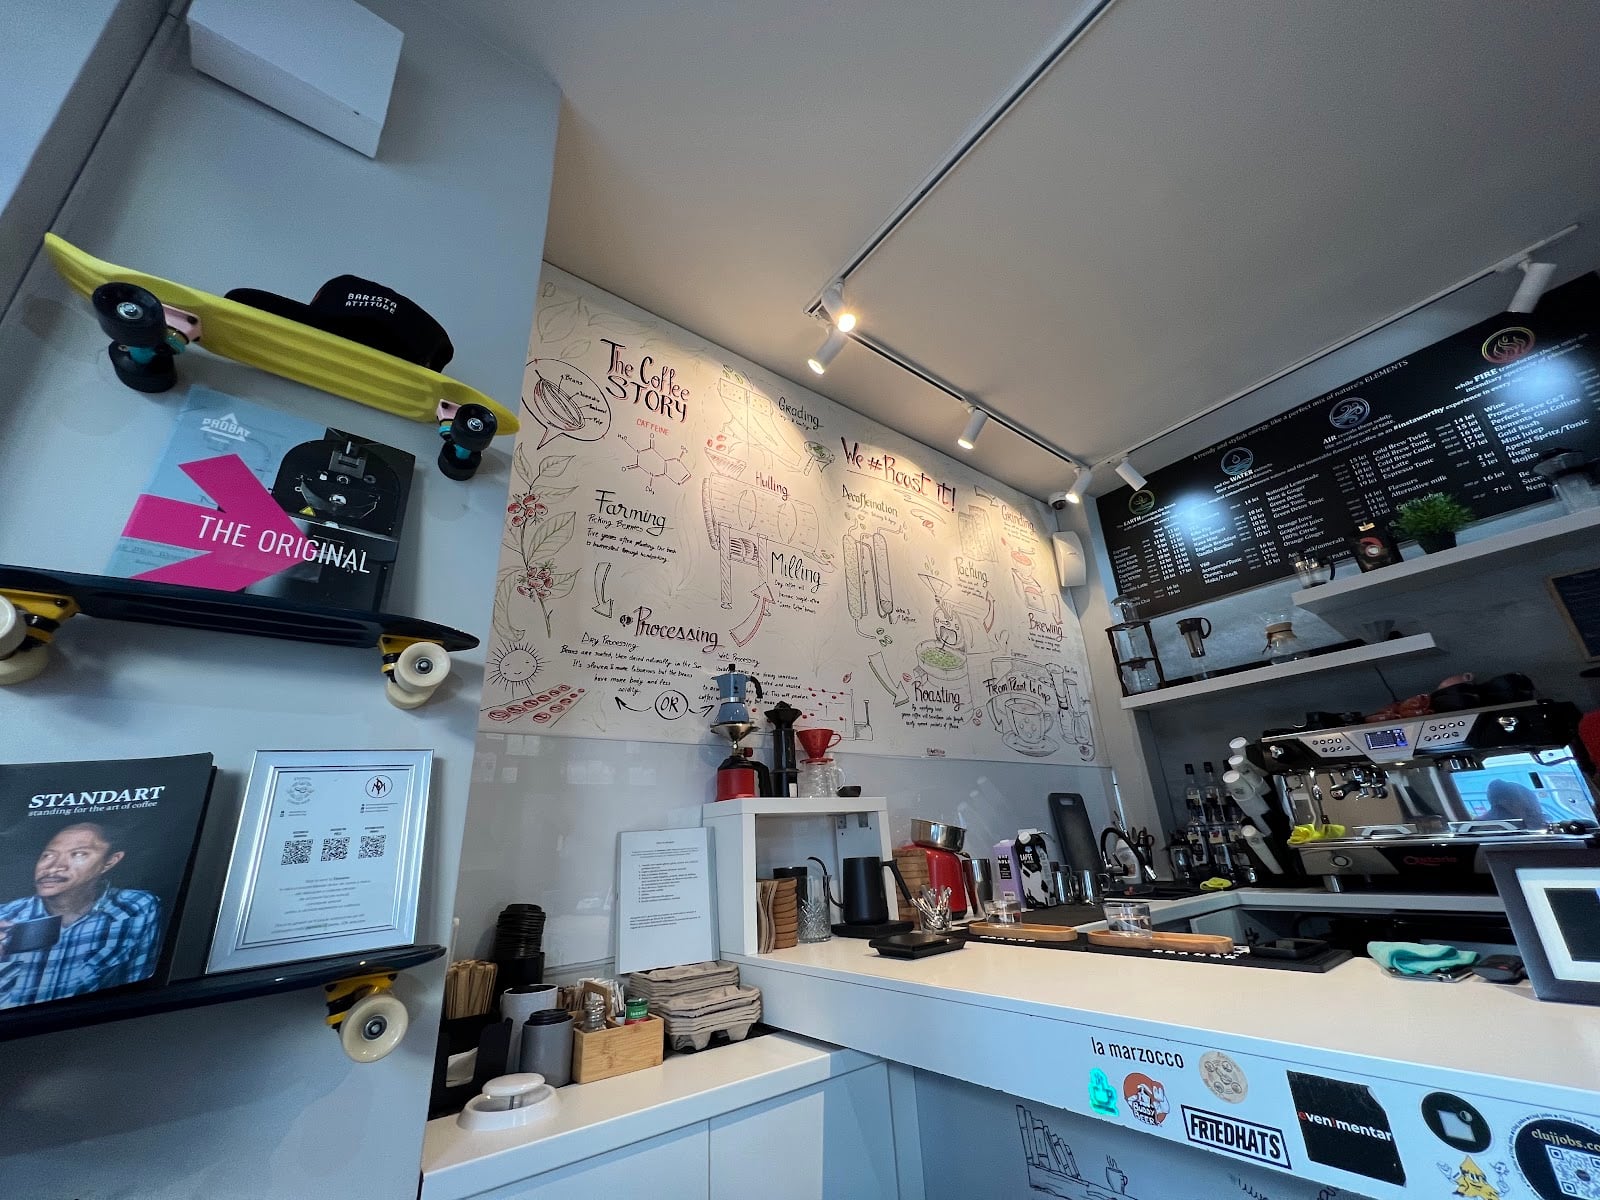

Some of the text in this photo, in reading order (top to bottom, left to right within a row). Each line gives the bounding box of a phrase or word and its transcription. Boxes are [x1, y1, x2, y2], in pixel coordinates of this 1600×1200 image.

[345, 301, 396, 315] ATTITUDE
[347, 293, 398, 309] BARISTA
[600, 338, 691, 402] The Coffee
[1454, 367, 1498, 392] while FIRE
[1465, 374, 1502, 394] incendiary
[605, 375, 688, 423] STORY
[1217, 440, 1228, 450] and
[1270, 417, 1283, 427] like
[1288, 404, 1311, 420] perfect
[1312, 397, 1327, 408] mix
[1327, 393, 1335, 402] of
[1334, 379, 1364, 399] nature's
[1364, 359, 1410, 384] ELEMENTS
[1392, 404, 1445, 431] #instaworthy
[1445, 392, 1482, 411] experience
[1491, 380, 1511, 392] every
[1483, 401, 1507, 415] Wine
[779, 396, 824, 431] Grading
[1454, 412, 1477, 426] 14 lei
[1487, 402, 1525, 421] Prosecco
[1490, 393, 1566, 427] Perfect Serve G&T
[1493, 397, 1581, 433] Elements Gin Collins
[202, 417, 251, 438] PROBAT
[636, 418, 670, 436] CAFFEINE
[1456, 418, 1479, 432] 15 lei
[1459, 425, 1482, 438] 16 lei
[1497, 419, 1541, 440] Gold Rush
[1323, 434, 1337, 445] AIR
[1372, 430, 1428, 457] Cold Brew Twist
[1500, 426, 1544, 448] Mint Julep
[1505, 418, 1590, 454] Aperol Spritz/Tonic
[1375, 437, 1431, 463] Cold Brew Tonic
[1377, 442, 1437, 469] Cold Brew Cooler
[1476, 450, 1495, 462] 2 lei
[1507, 447, 1531, 460] Hugo
[1511, 452, 1539, 467] Mojito
[1380, 459, 1410, 474] Ice Latte
[1382, 457, 1435, 480] Espresso Tonic
[1480, 457, 1499, 469] 3 lei
[841, 436, 864, 470] We
[867, 454, 932, 497] #Roast
[936, 482, 957, 514] it!
[1229, 468, 1254, 483] WATER
[1387, 477, 1419, 493] Flavours
[1482, 470, 1506, 484] 16 lei
[755, 471, 791, 502] Hulling
[1267, 493, 1281, 503] Mint
[1286, 485, 1306, 498] Ginger
[1391, 474, 1448, 500] Alternative milk
[1493, 483, 1513, 496] 7 lei
[842, 484, 898, 518] Decaffeination
[1309, 496, 1325, 507] Tonic
[588, 513, 613, 530] Picking
[595, 489, 674, 537] Farming
[1001, 504, 1038, 536] Grinding
[1277, 518, 1298, 531] Orange
[198, 515, 370, 574] THE ORIGINAL
[1283, 536, 1305, 550] Orange
[771, 551, 827, 594] Milling
[955, 556, 990, 588] Packing
[633, 605, 724, 653] Processing
[615, 652, 628, 660] then
[629, 654, 644, 663] dried
[682, 660, 691, 668] the
[594, 673, 607, 683] have
[629, 675, 645, 686] body
[911, 680, 965, 711] Roasting
[982, 677, 1008, 697] From
[1008, 676, 1027, 693] Plant
[1037, 684, 1051, 706] Cup
[660, 696, 679, 713] OR
[28, 786, 166, 809] STANDART
[28, 808, 72, 817] standing
[73, 806, 87, 814] for
[89, 804, 105, 813] the
[106, 804, 118, 812] art
[131, 800, 158, 810] coffee
[1090, 1036, 1185, 1070] la marzocco
[1190, 1113, 1282, 1160] FRIEDHATS
